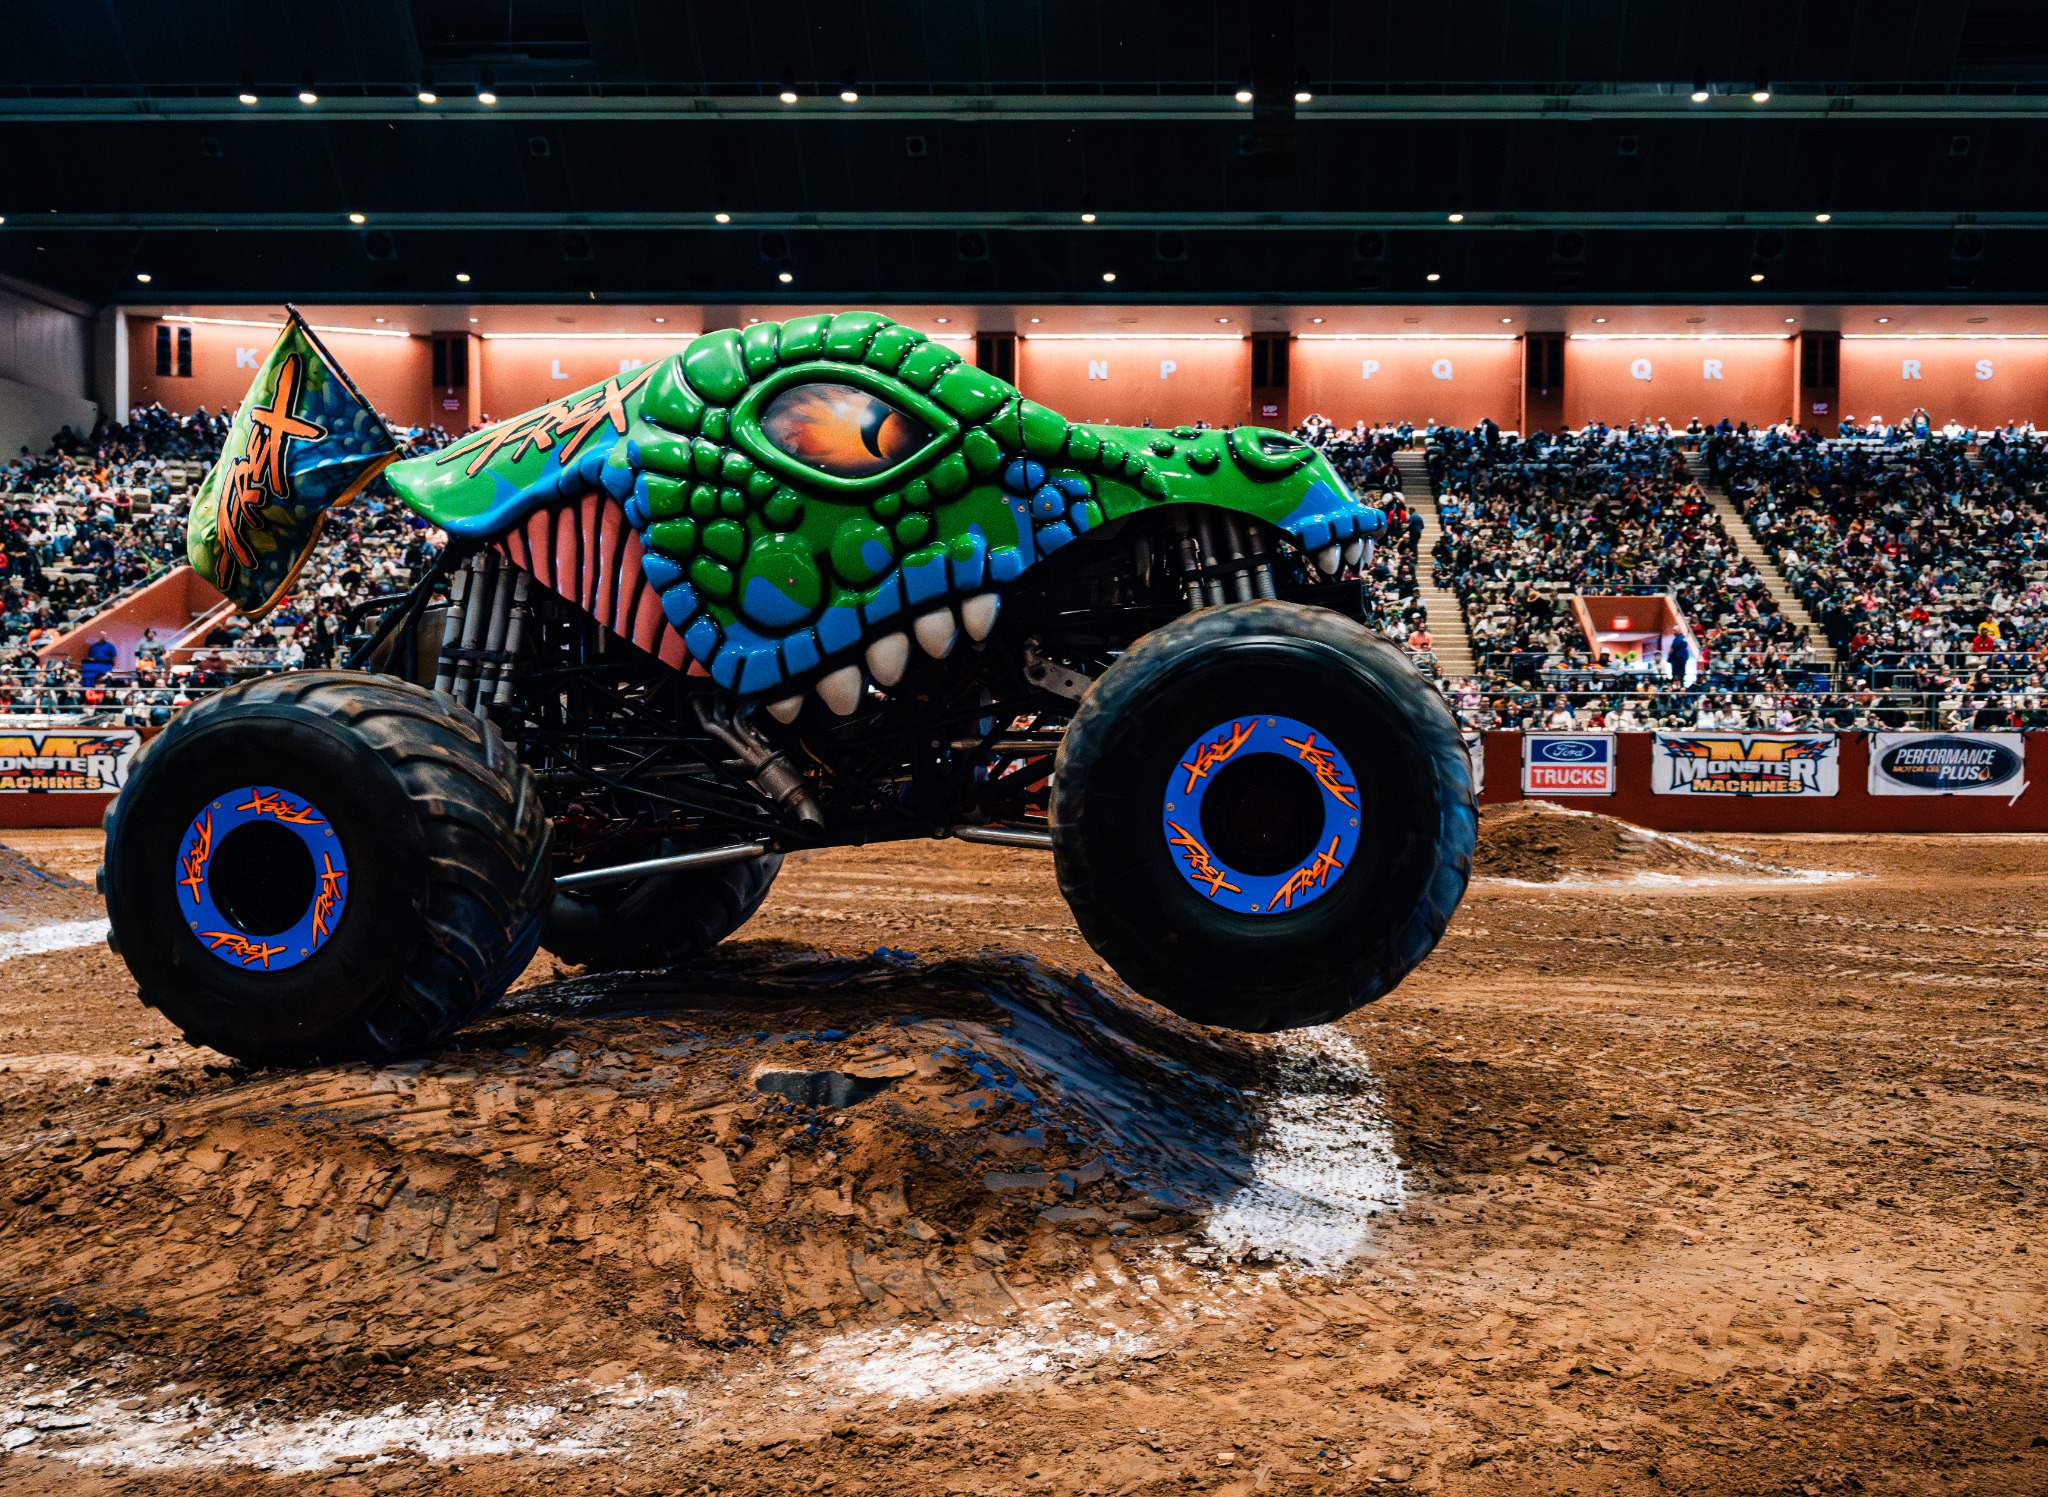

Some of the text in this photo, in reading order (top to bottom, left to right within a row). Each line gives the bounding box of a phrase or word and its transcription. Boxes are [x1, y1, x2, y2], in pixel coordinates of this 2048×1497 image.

[236, 348, 258, 369] K
[552, 360, 641, 379] L M
[1089, 360, 1177, 380] N P
[1363, 359, 1453, 380] P Q
[1631, 359, 1723, 381] Q R
[1903, 359, 1993, 380] R S
[1552, 743, 1586, 757] Ford
[1894, 748, 1997, 766] PERFORMANCE
[0, 754, 120, 788] ONSTER
[1533, 769, 1605, 785] TRUCKS
[1672, 757, 1819, 791] MONSTER
[1892, 765, 1924, 773] MOTOR
[1939, 765, 1981, 780] PLUS
[0, 776, 101, 789] ACHINES
[1692, 779, 1803, 793] MACHINES
